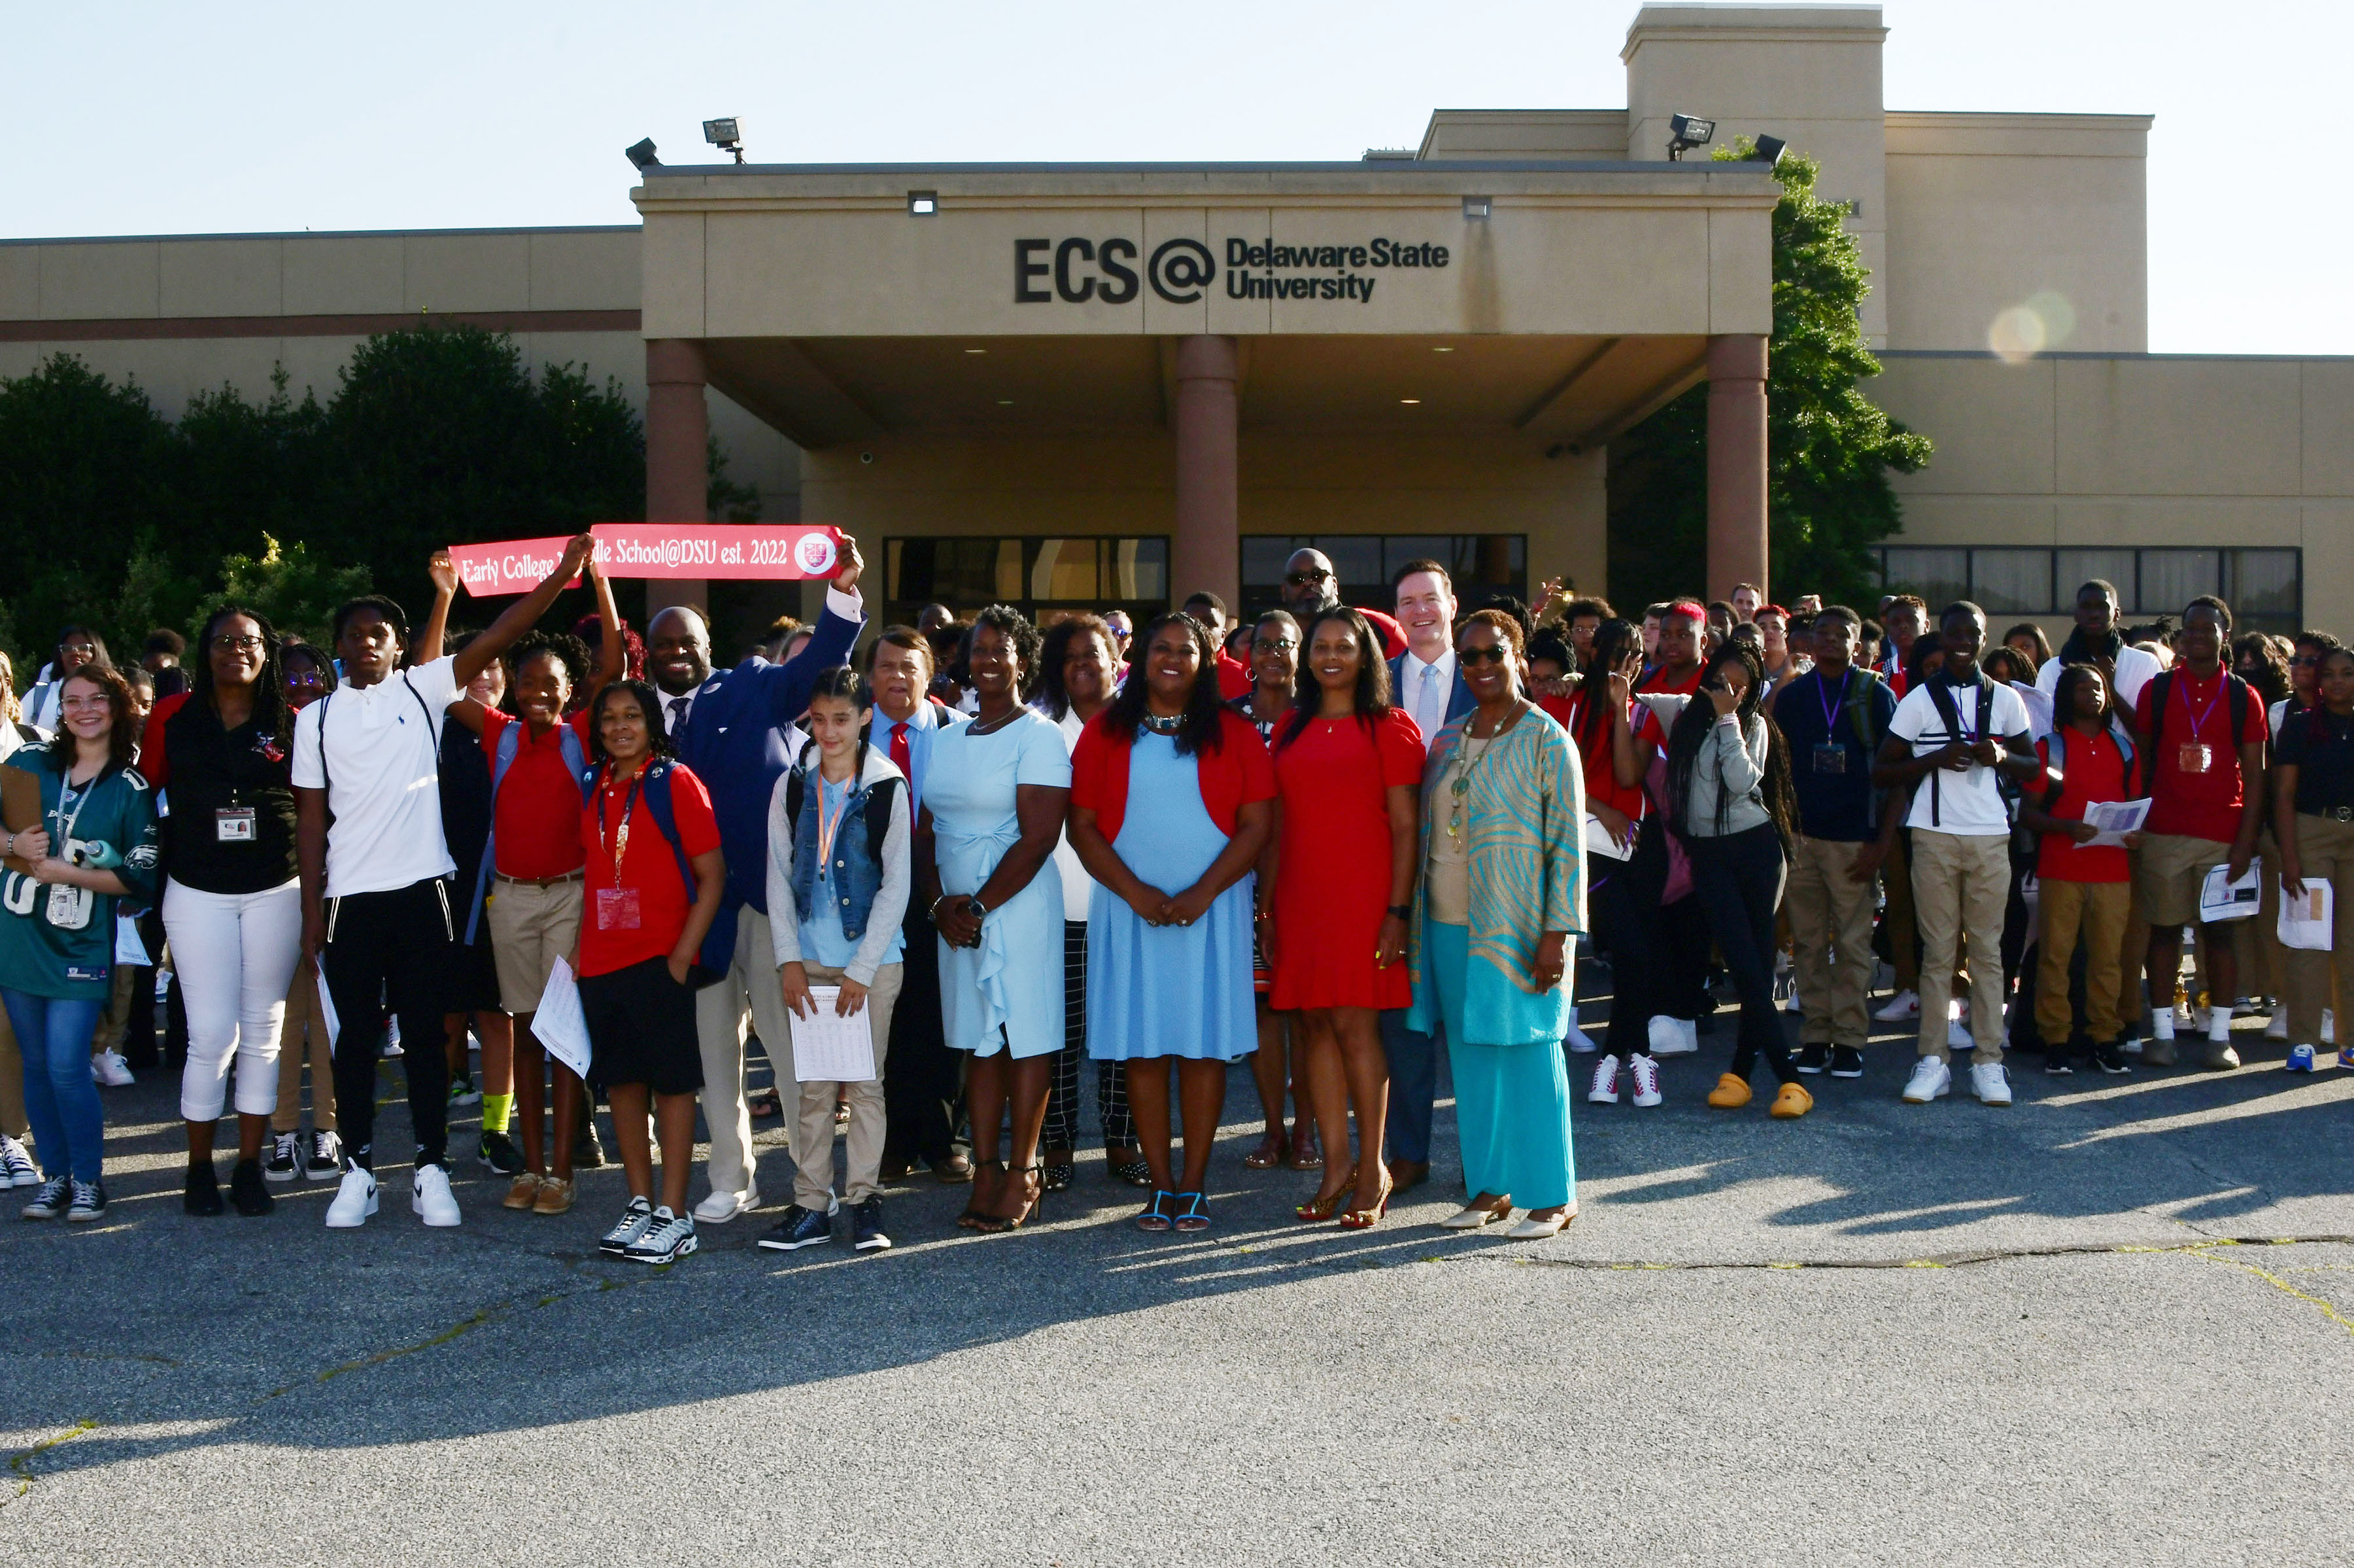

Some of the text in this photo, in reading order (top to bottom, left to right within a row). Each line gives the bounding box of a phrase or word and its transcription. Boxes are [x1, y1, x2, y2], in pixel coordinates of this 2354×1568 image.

[1227, 238, 1449, 267] Delaware State
[1227, 270, 1375, 303] University
[462, 557, 499, 587] Early
[503, 554, 554, 583] College
[616, 539, 717, 568] School@DSU
[721, 541, 745, 564] est.
[750, 539, 787, 565] 2022
